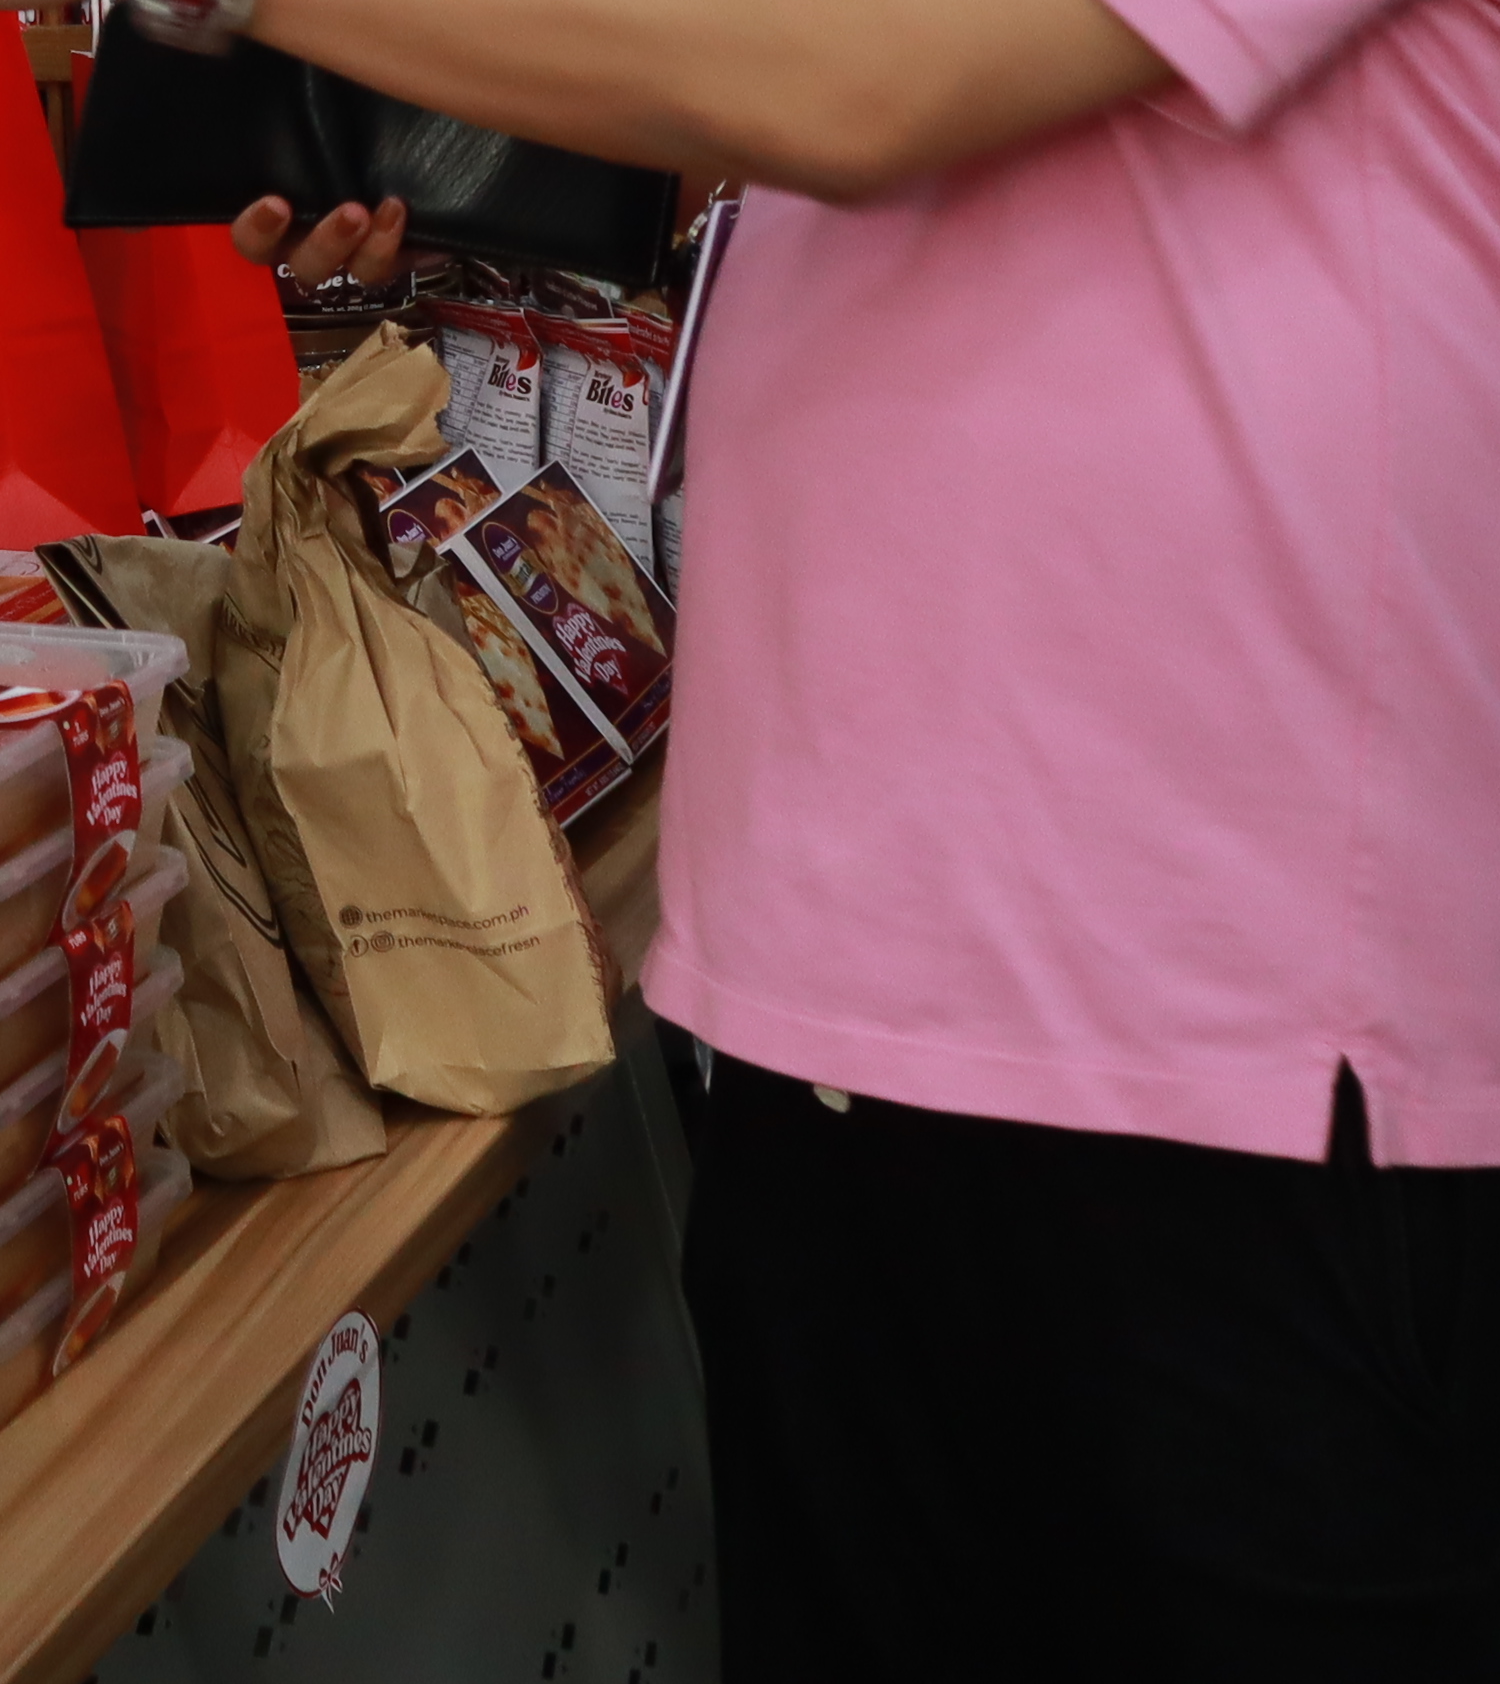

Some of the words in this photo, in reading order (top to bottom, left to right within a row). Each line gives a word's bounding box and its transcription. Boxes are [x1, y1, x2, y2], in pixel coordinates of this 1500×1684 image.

[487, 363, 532, 395] Bites
[586, 379, 634, 412] Bites
[554, 609, 598, 653] Happy
[574, 634, 628, 685] Valentines
[593, 658, 622, 683] Day
[92, 759, 128, 796] Happy
[86, 782, 138, 826] Valentines
[103, 804, 122, 826] Day
[89, 959, 122, 997] Happy
[96, 1005, 113, 1026] Day
[88, 1204, 125, 1247] Happy
[83, 1227, 134, 1279] Valentines
[99, 1251, 118, 1275] Day
[301, 1357, 328, 1430] Don
[328, 1322, 370, 1367] Juan's
[311, 1468, 346, 1525] Day
